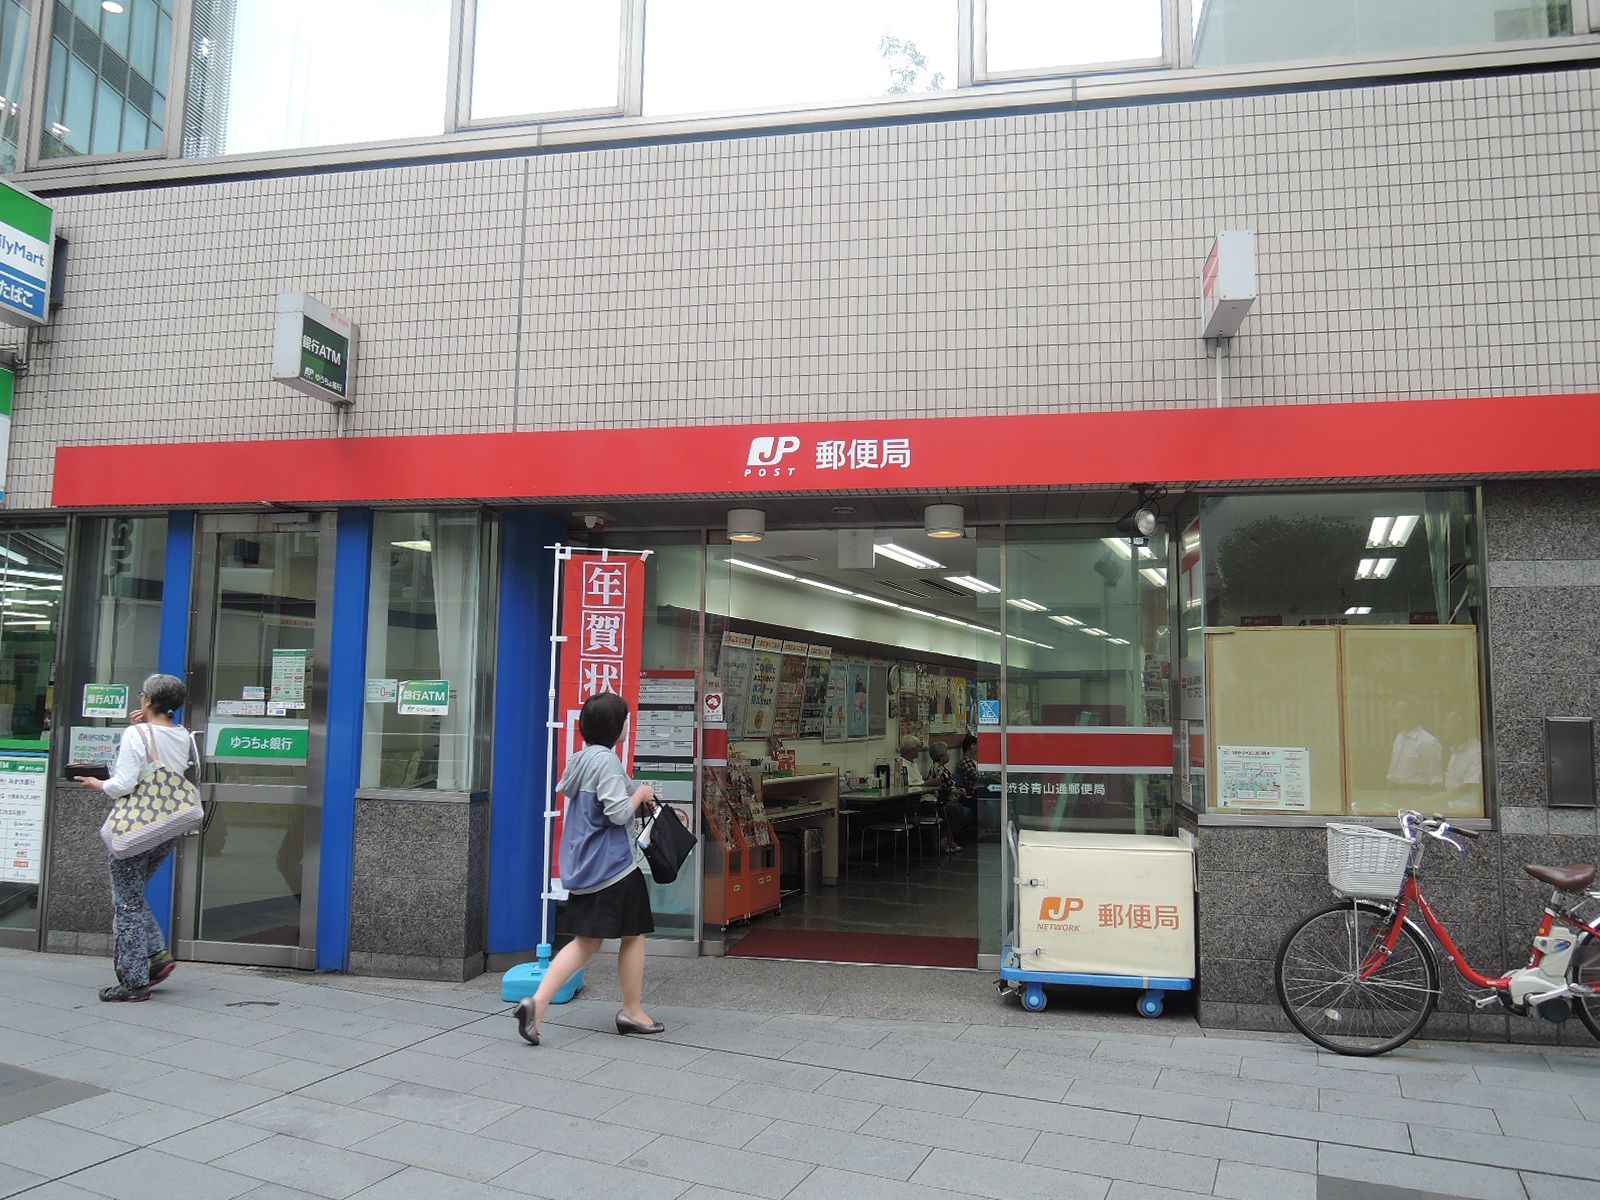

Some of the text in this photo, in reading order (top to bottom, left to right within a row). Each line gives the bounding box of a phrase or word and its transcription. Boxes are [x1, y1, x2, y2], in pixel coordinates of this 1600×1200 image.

[302, 335, 341, 366] 銀行ATM
[747, 436, 800, 466] JP
[815, 439, 911, 470] 郵便局
[744, 467, 795, 477] POST
[583, 567, 622, 699] 年賀状
[402, 689, 446, 702] 銀行ATM
[230, 735, 294, 751] ゆうちょ銀行
[1006, 782, 1106, 796] 渋谷青山通郵便局
[1037, 922, 1081, 933] NETWORK
[1098, 903, 1180, 931] 郵便局
